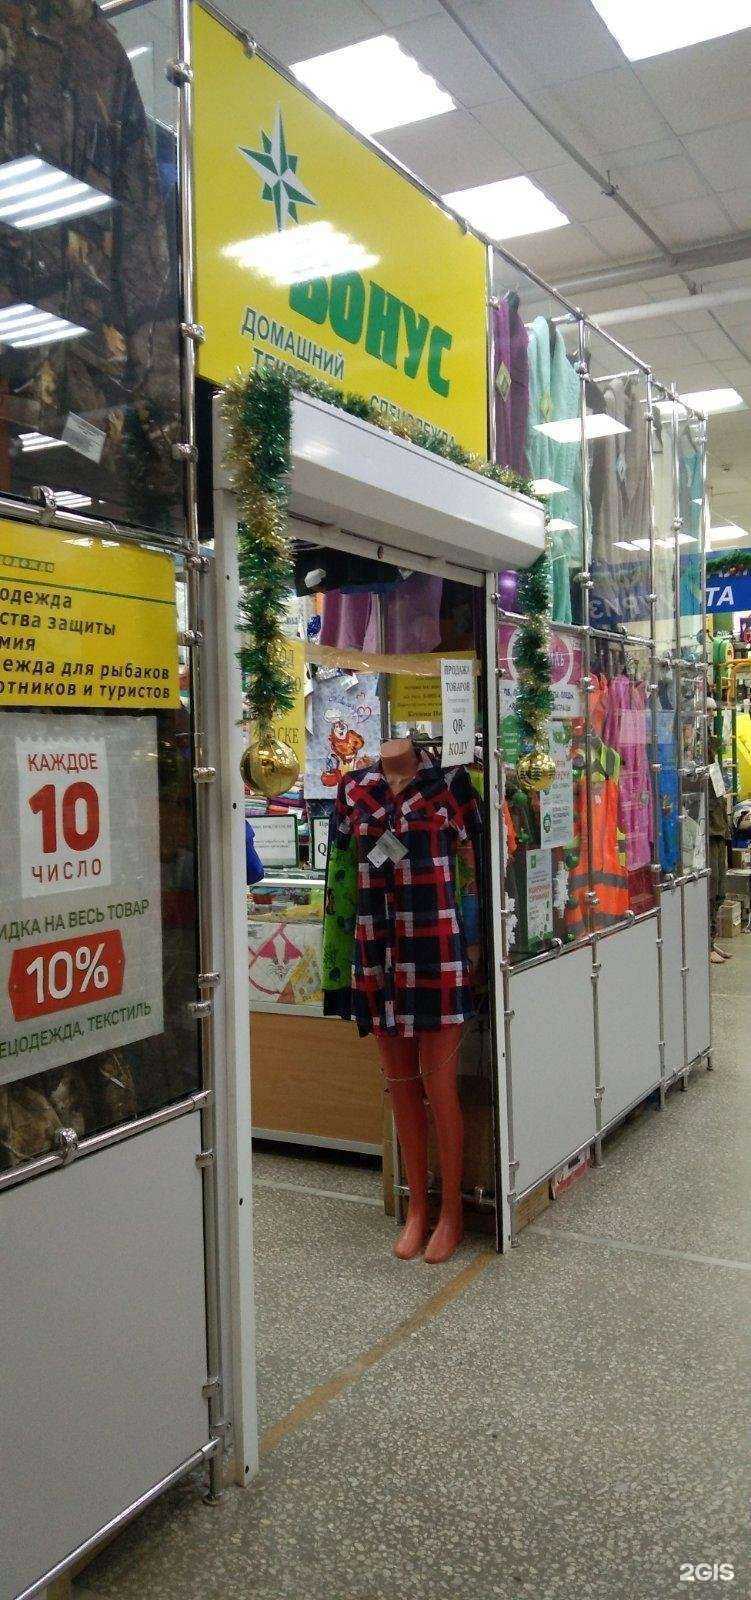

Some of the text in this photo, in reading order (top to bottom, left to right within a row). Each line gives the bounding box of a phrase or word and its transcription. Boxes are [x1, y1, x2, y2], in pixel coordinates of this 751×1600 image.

[242, 308, 345, 380] ДОМАШНИЙ
[0, 588, 72, 609] одежда
[0, 612, 116, 636] ства защиты
[0, 636, 35, 651] мия
[3, 659, 169, 679] ежда для рыбаков
[83, 683, 93, 694] и
[100, 684, 169, 700] туристов
[28, 753, 98, 773] КАЖДОЕ
[28, 781, 100, 853] 10
[32, 859, 102, 883] ЧИСЛО
[45, 914, 65, 933] НА
[69, 908, 105, 928] ВЕСЬ
[107, 900, 149, 920] ТОВАР
[26, 942, 109, 1004] 10%
[87, 1002, 152, 1032] ТЕКСТИЛЬ
